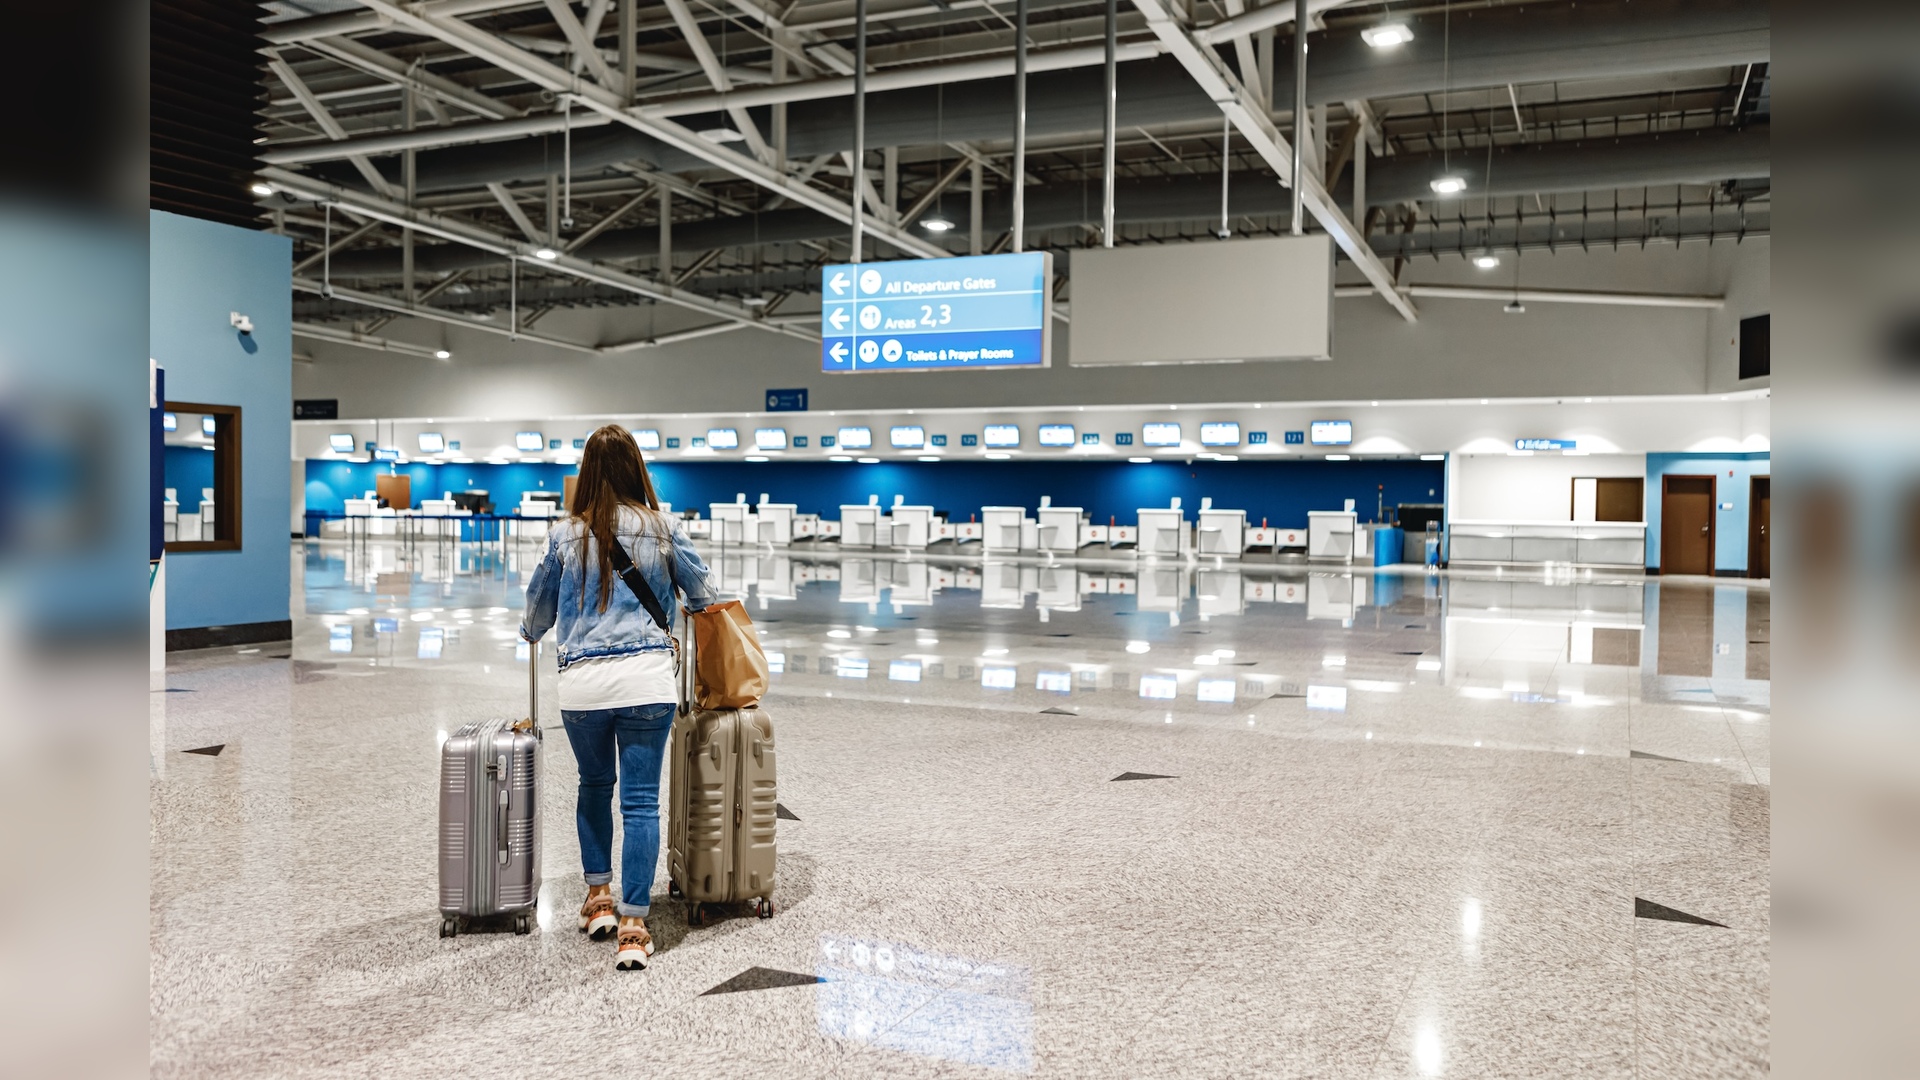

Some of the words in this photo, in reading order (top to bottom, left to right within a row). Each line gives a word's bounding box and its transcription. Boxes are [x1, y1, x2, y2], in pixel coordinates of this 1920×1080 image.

[885, 281, 901, 294] All
[903, 279, 960, 295] Departure
[963, 277, 996, 290] Gates
[884, 317, 916, 330] Areas
[920, 304, 952, 328] 2,3
[906, 350, 938, 362] Toilets
[938, 349, 947, 361] &
[948, 348, 979, 362] Prayer
[980, 347, 1014, 359] Rooms
[797, 393, 803, 408] 1
